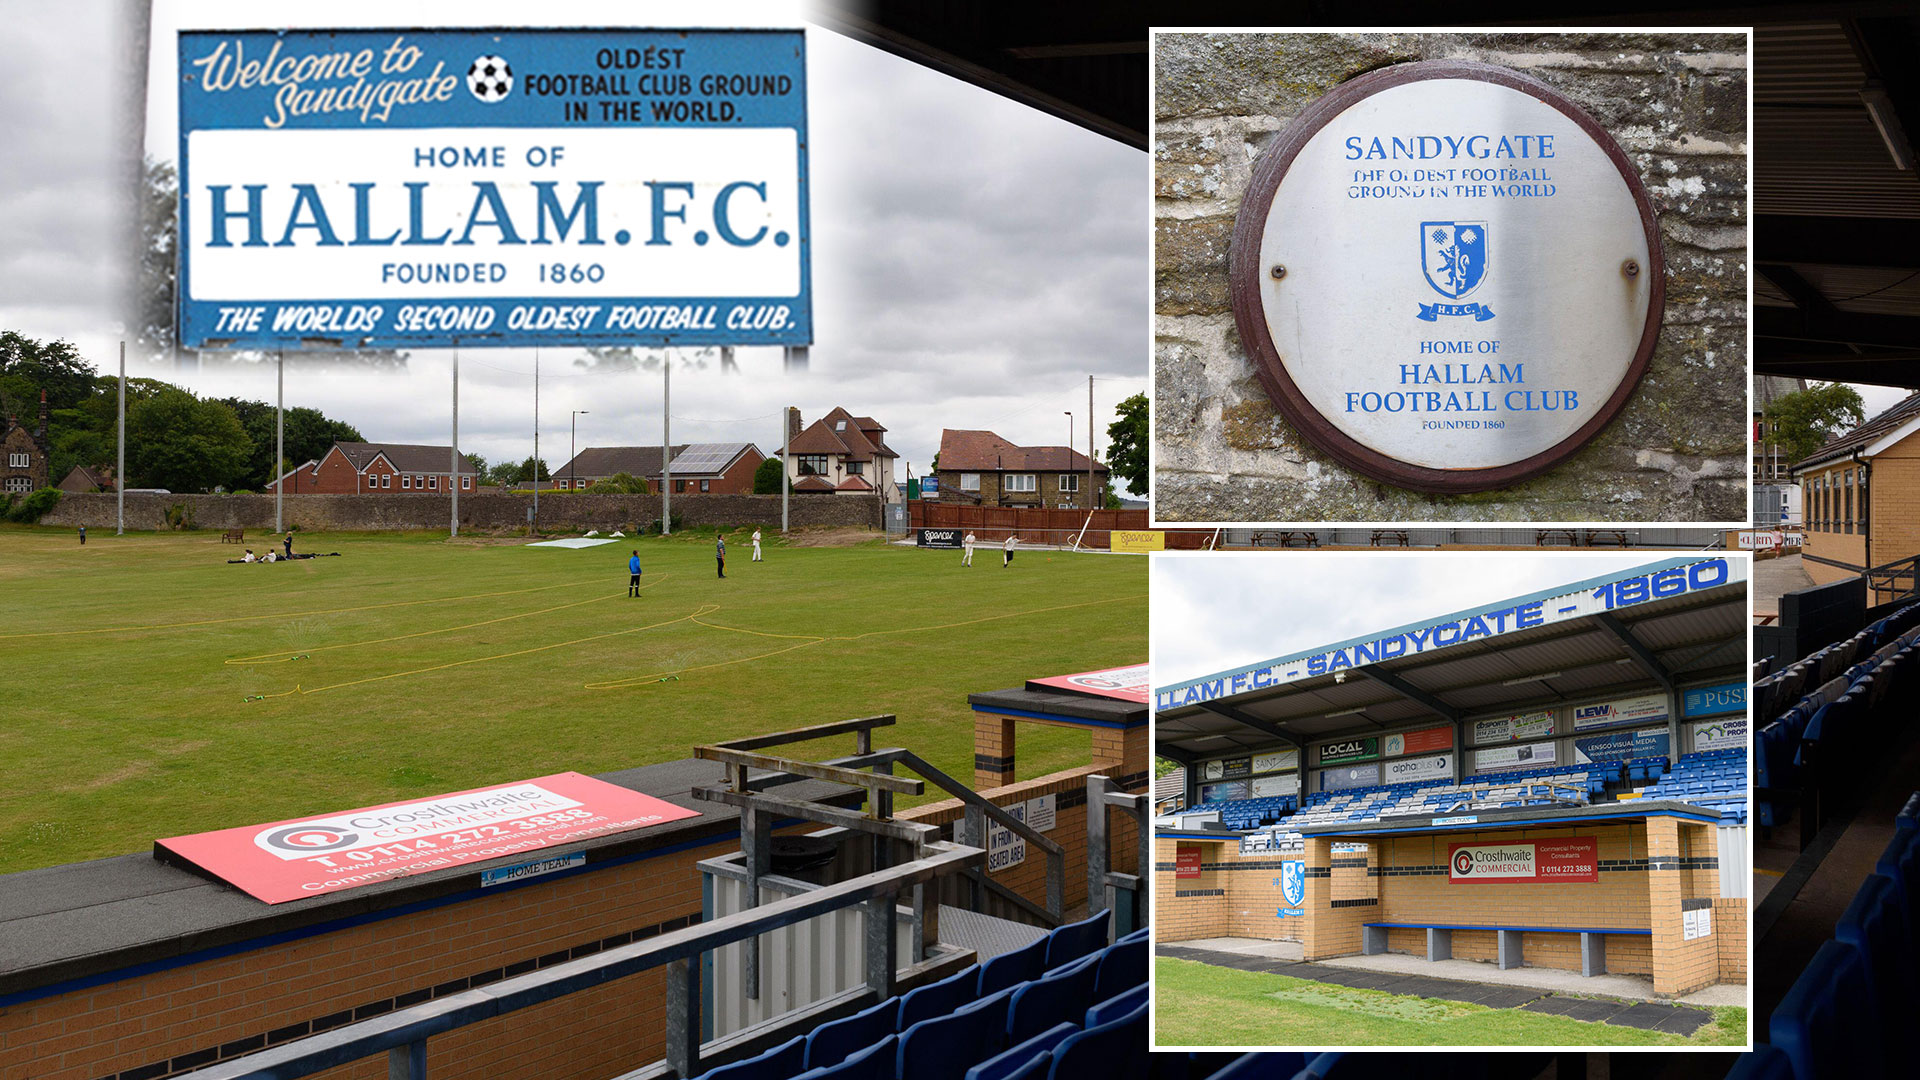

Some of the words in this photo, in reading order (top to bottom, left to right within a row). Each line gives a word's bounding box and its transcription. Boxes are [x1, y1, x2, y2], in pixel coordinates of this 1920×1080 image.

[193, 40, 374, 92] Welcome
[380, 36, 424, 75] to
[596, 47, 686, 70] OLDEST
[263, 60, 458, 128] Sandygate
[524, 73, 631, 97] FOOTBALL
[638, 73, 692, 97] CLUB
[699, 73, 792, 97] GROUND
[564, 101, 588, 123] IN
[600, 101, 642, 123] THE
[650, 101, 743, 123] WORLD.
[413, 146, 505, 168] HOME
[525, 146, 565, 168] OF
[1345, 135, 1556, 160] SANDYGATE
[1462, 167, 1552, 182] FOOTBALL
[1348, 185, 1425, 199] GROUND
[1430, 185, 1449, 199] IN
[1453, 185, 1488, 198] THE
[1491, 184, 1557, 198] WORLD
[381, 262, 507, 284] FOUNDED
[539, 262, 605, 284] 1860
[215, 306, 266, 332] THE
[271, 305, 383, 332] WORLDS
[393, 305, 496, 331] SECOND
[507, 305, 600, 330] OLDEST
[605, 305, 717, 330] FOOTBALL
[726, 305, 797, 330] CLUB.
[1419, 341, 1474, 354] HOME
[1477, 340, 1501, 353] OF
[1399, 363, 1525, 385] HALLAM
[1344, 390, 1498, 413] FOOTBALL
[1504, 390, 1579, 412] CLUB
[1422, 420, 1480, 430] FOUNDED
[1482, 420, 1505, 430] 1860
[1231, 667, 1278, 695] F.C.
[1307, 600, 1544, 677] SANDYGATE
[1593, 558, 1728, 610] 1860
[1576, 704, 1610, 719] LEW
[1321, 741, 1363, 756] LOCAL
[1612, 741, 1634, 749] VISUAL
[350, 790, 542, 829] Crosthwaite
[373, 800, 565, 838] COMMERCIAL
[307, 855, 338, 868] T
[345, 839, 438, 861] 0114
[440, 825, 511, 844] 272
[508, 808, 594, 830] 3888
[1539, 845, 1569, 853] Commercial
[1569, 844, 1591, 852] Property
[301, 856, 453, 891] Commercial
[452, 837, 547, 861] Property
[547, 813, 663, 841] Consultants
[989, 849, 1010, 870] SEATED
[1010, 844, 1025, 862] AREA
[1475, 849, 1532, 863] Crosthwaite
[1550, 852, 1580, 860] Consultants
[506, 864, 541, 879] HOME
[541, 855, 572, 872] TEAM
[1475, 864, 1532, 874] COMMERCIAL
[1546, 865, 1561, 873] 0114
[1562, 864, 1575, 873] 272
